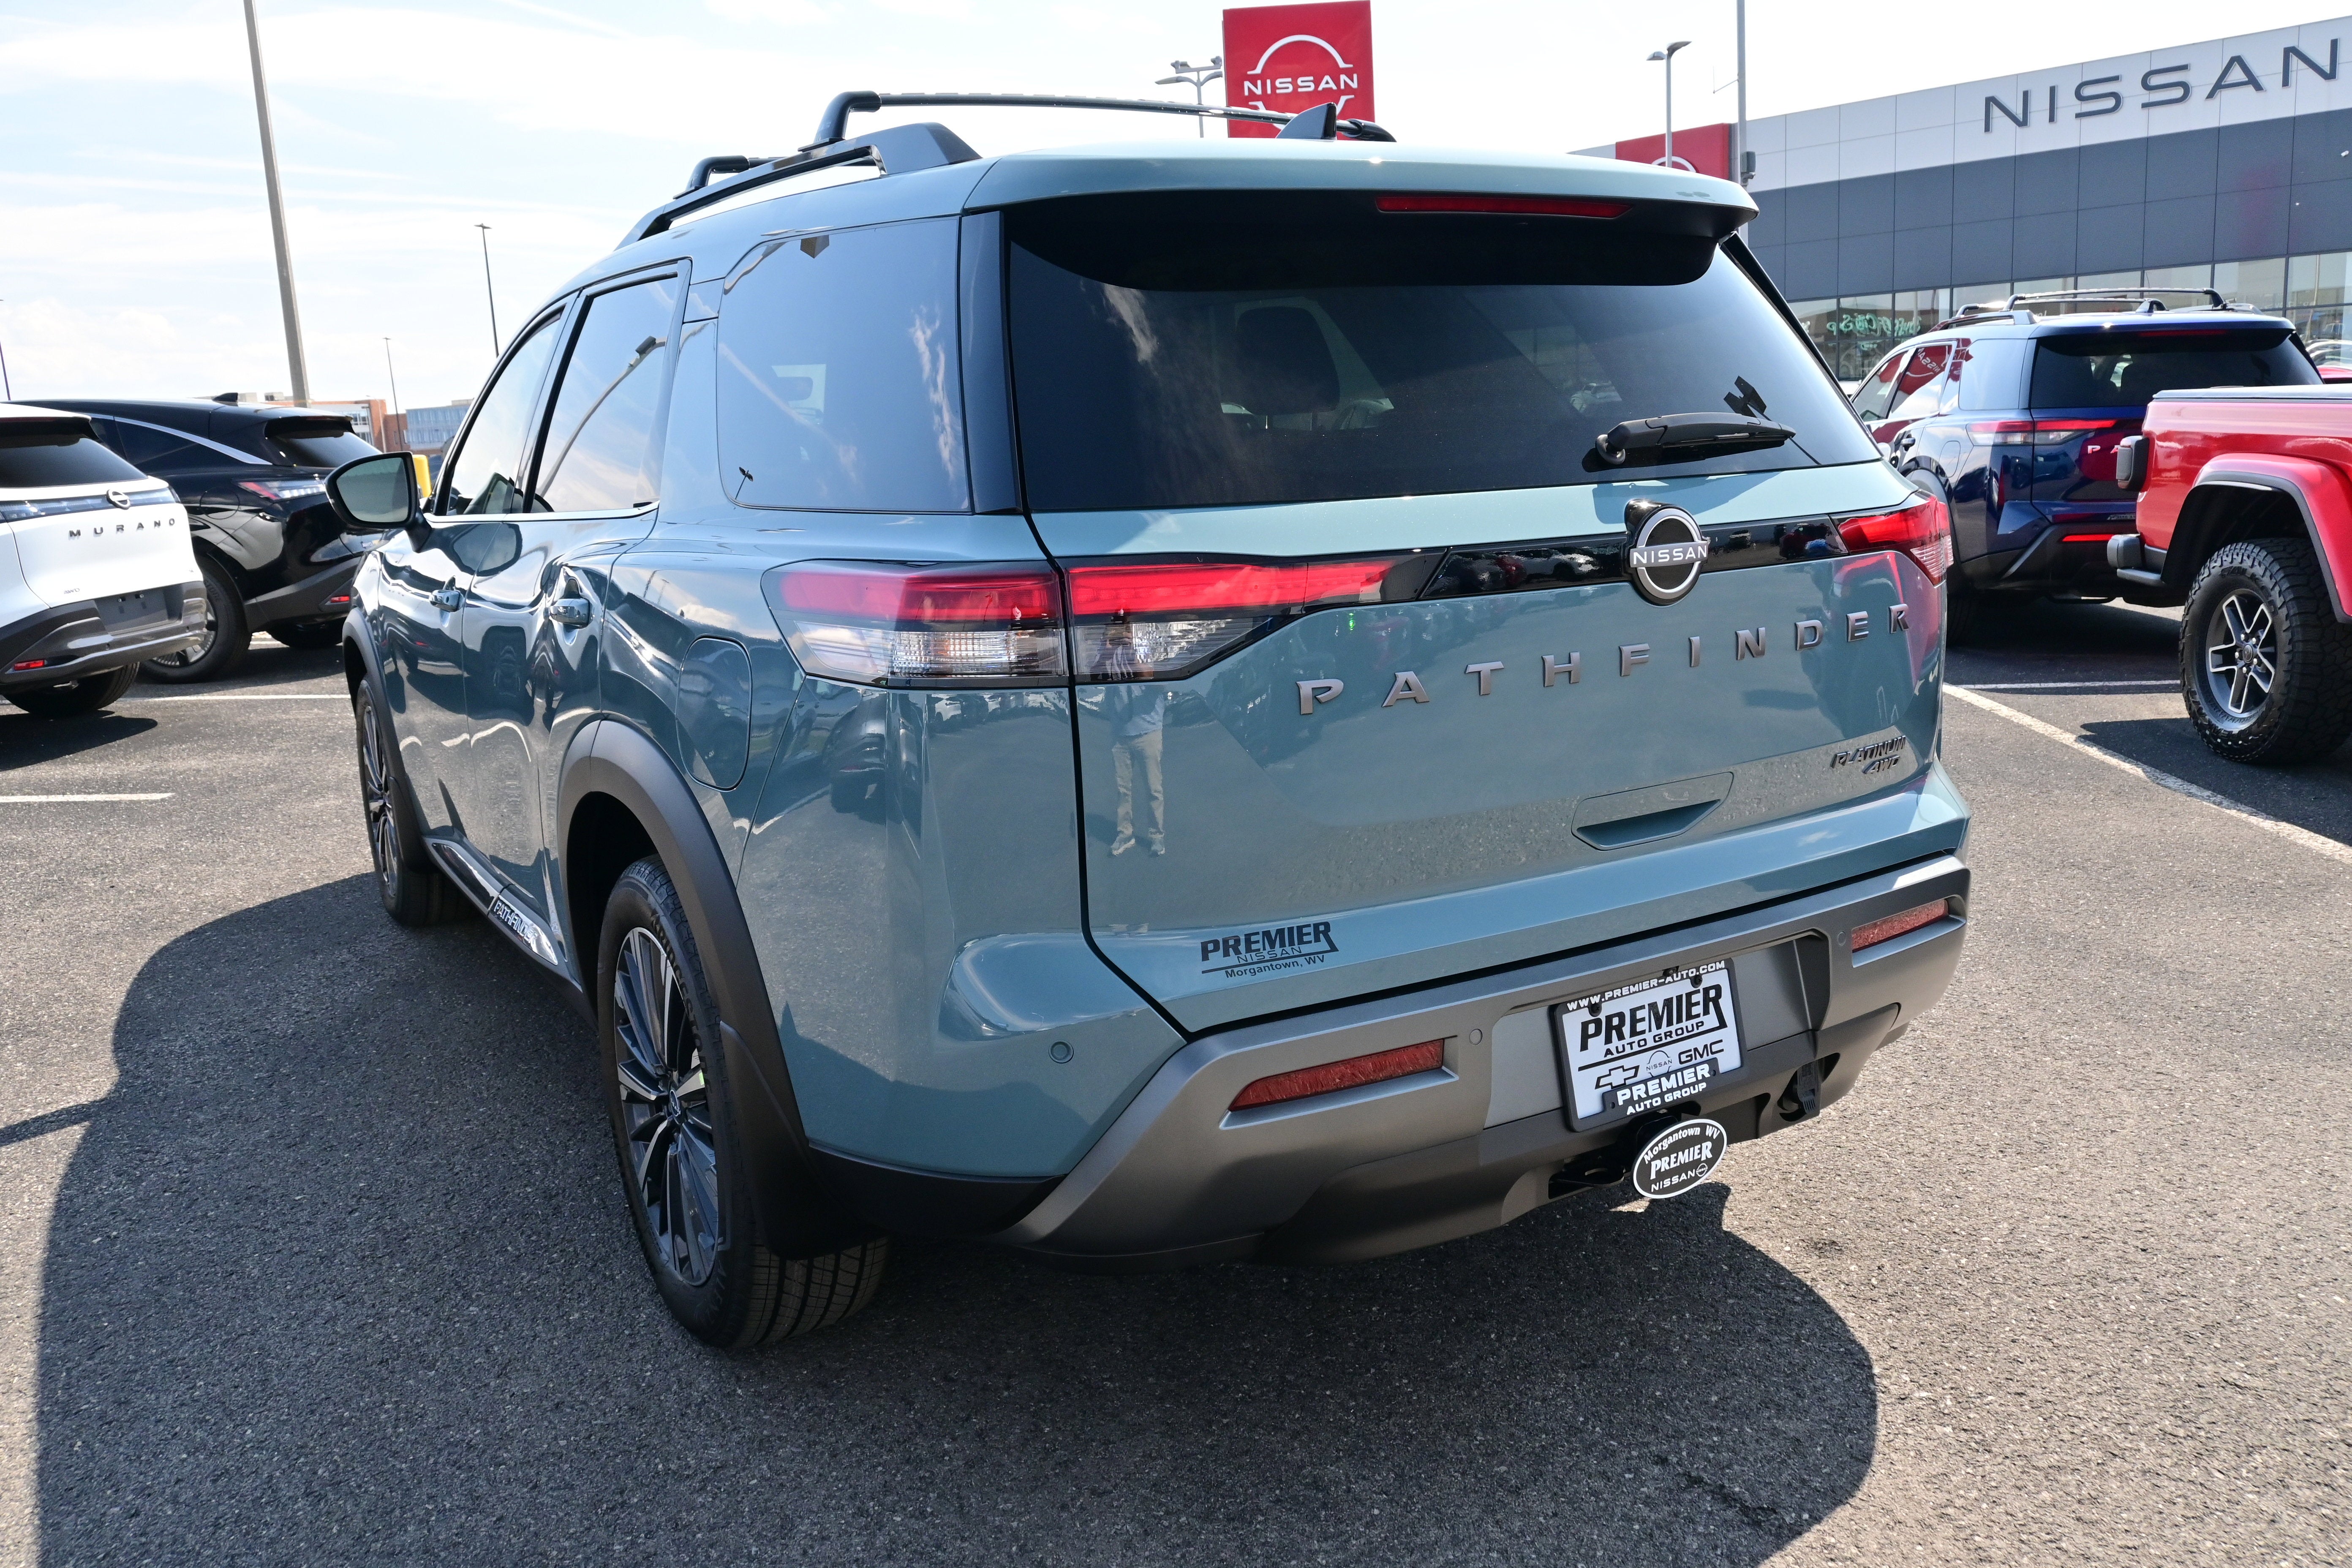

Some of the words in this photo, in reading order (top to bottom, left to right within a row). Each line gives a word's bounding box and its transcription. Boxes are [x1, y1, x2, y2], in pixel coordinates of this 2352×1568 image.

[1244, 74, 1358, 96] NISSAN
[1984, 38, 2339, 133] NISSAN
[69, 518, 175, 537] MURANO
[1633, 545, 1708, 566] NISSAN
[1296, 603, 1910, 715] PATHFINDER
[1830, 735, 1906, 768] PLATINUM
[494, 900, 538, 943] PATHFINDER
[1200, 921, 1339, 962] PREMIER
[1237, 946, 1302, 964] NISSAN
[1225, 960, 1303, 978] Morgantown,
[1304, 955, 1325, 966] WV
[1567, 961, 1725, 1011] WWW.PREMIER-AUTO.COM
[1580, 983, 1728, 1052] PREMIER
[1604, 1038, 1647, 1058] AUTO
[1653, 1021, 1704, 1043] GROUP
[1679, 1040, 1724, 1064] GMC
[1646, 1059, 1672, 1071] NISSAN
[1617, 1063, 1710, 1106] PREMIER
[1627, 1097, 1661, 1115] AUTO
[1664, 1082, 1707, 1102] GROUP
[1644, 1127, 1701, 1164] Morgantown
[1705, 1125, 1720, 1139] WV
[1650, 1141, 1712, 1179] PREMIER
[1651, 1169, 1695, 1192] NISSAN
